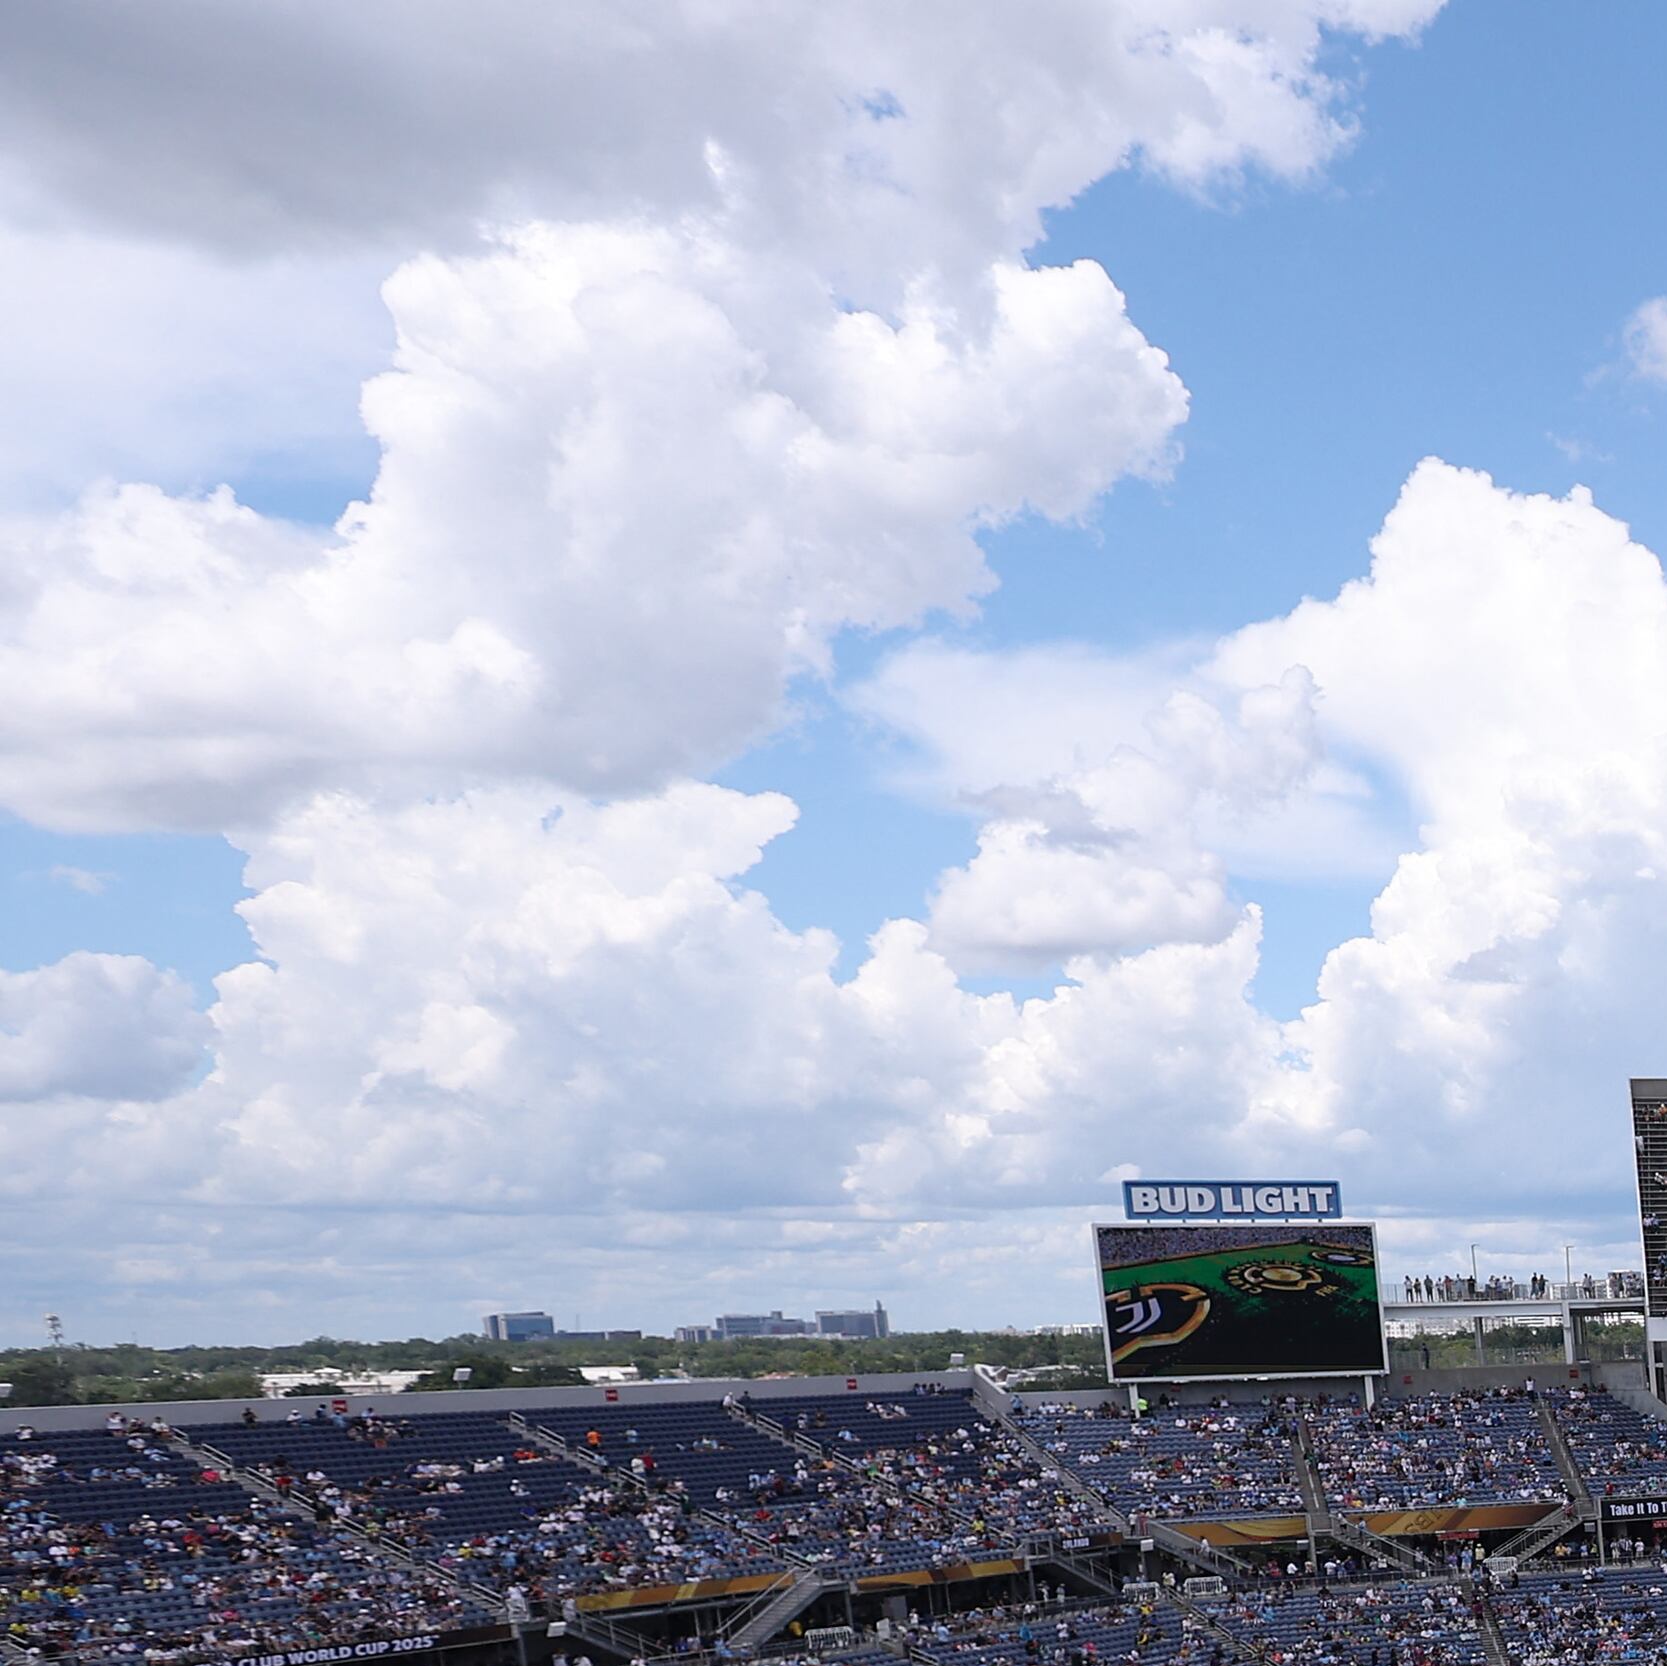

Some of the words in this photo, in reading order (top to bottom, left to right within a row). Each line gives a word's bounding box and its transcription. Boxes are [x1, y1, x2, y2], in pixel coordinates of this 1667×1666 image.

[1131, 1188, 1217, 1213] BUD
[1220, 1186, 1334, 1213] LIGHT
[1609, 1503, 1634, 1516] Take
[1636, 1503, 1645, 1515] It
[1646, 1502, 1658, 1514] To
[355, 1641, 390, 1660] CUP
